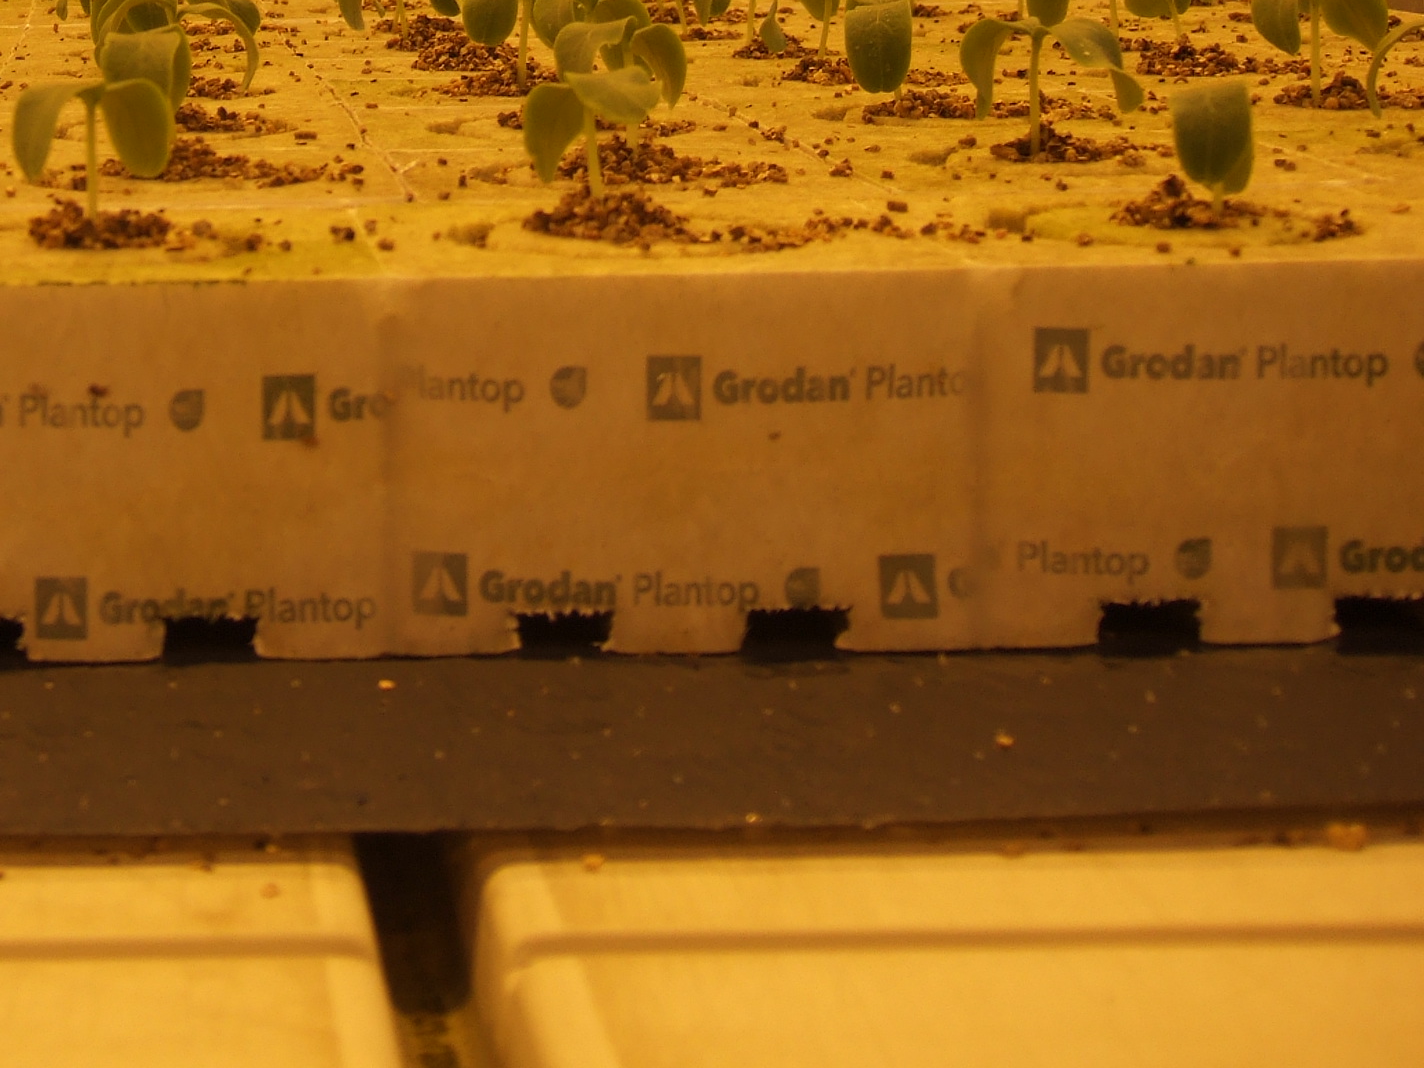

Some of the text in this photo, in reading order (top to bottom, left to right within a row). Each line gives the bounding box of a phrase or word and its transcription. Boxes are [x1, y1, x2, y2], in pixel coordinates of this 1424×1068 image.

[1257, 343, 1389, 387] Plantop
[18, 390, 146, 437] Plantop
[1017, 540, 1150, 585] Plantop
[245, 587, 377, 630] Plantop
[633, 571, 760, 613] Plantop
